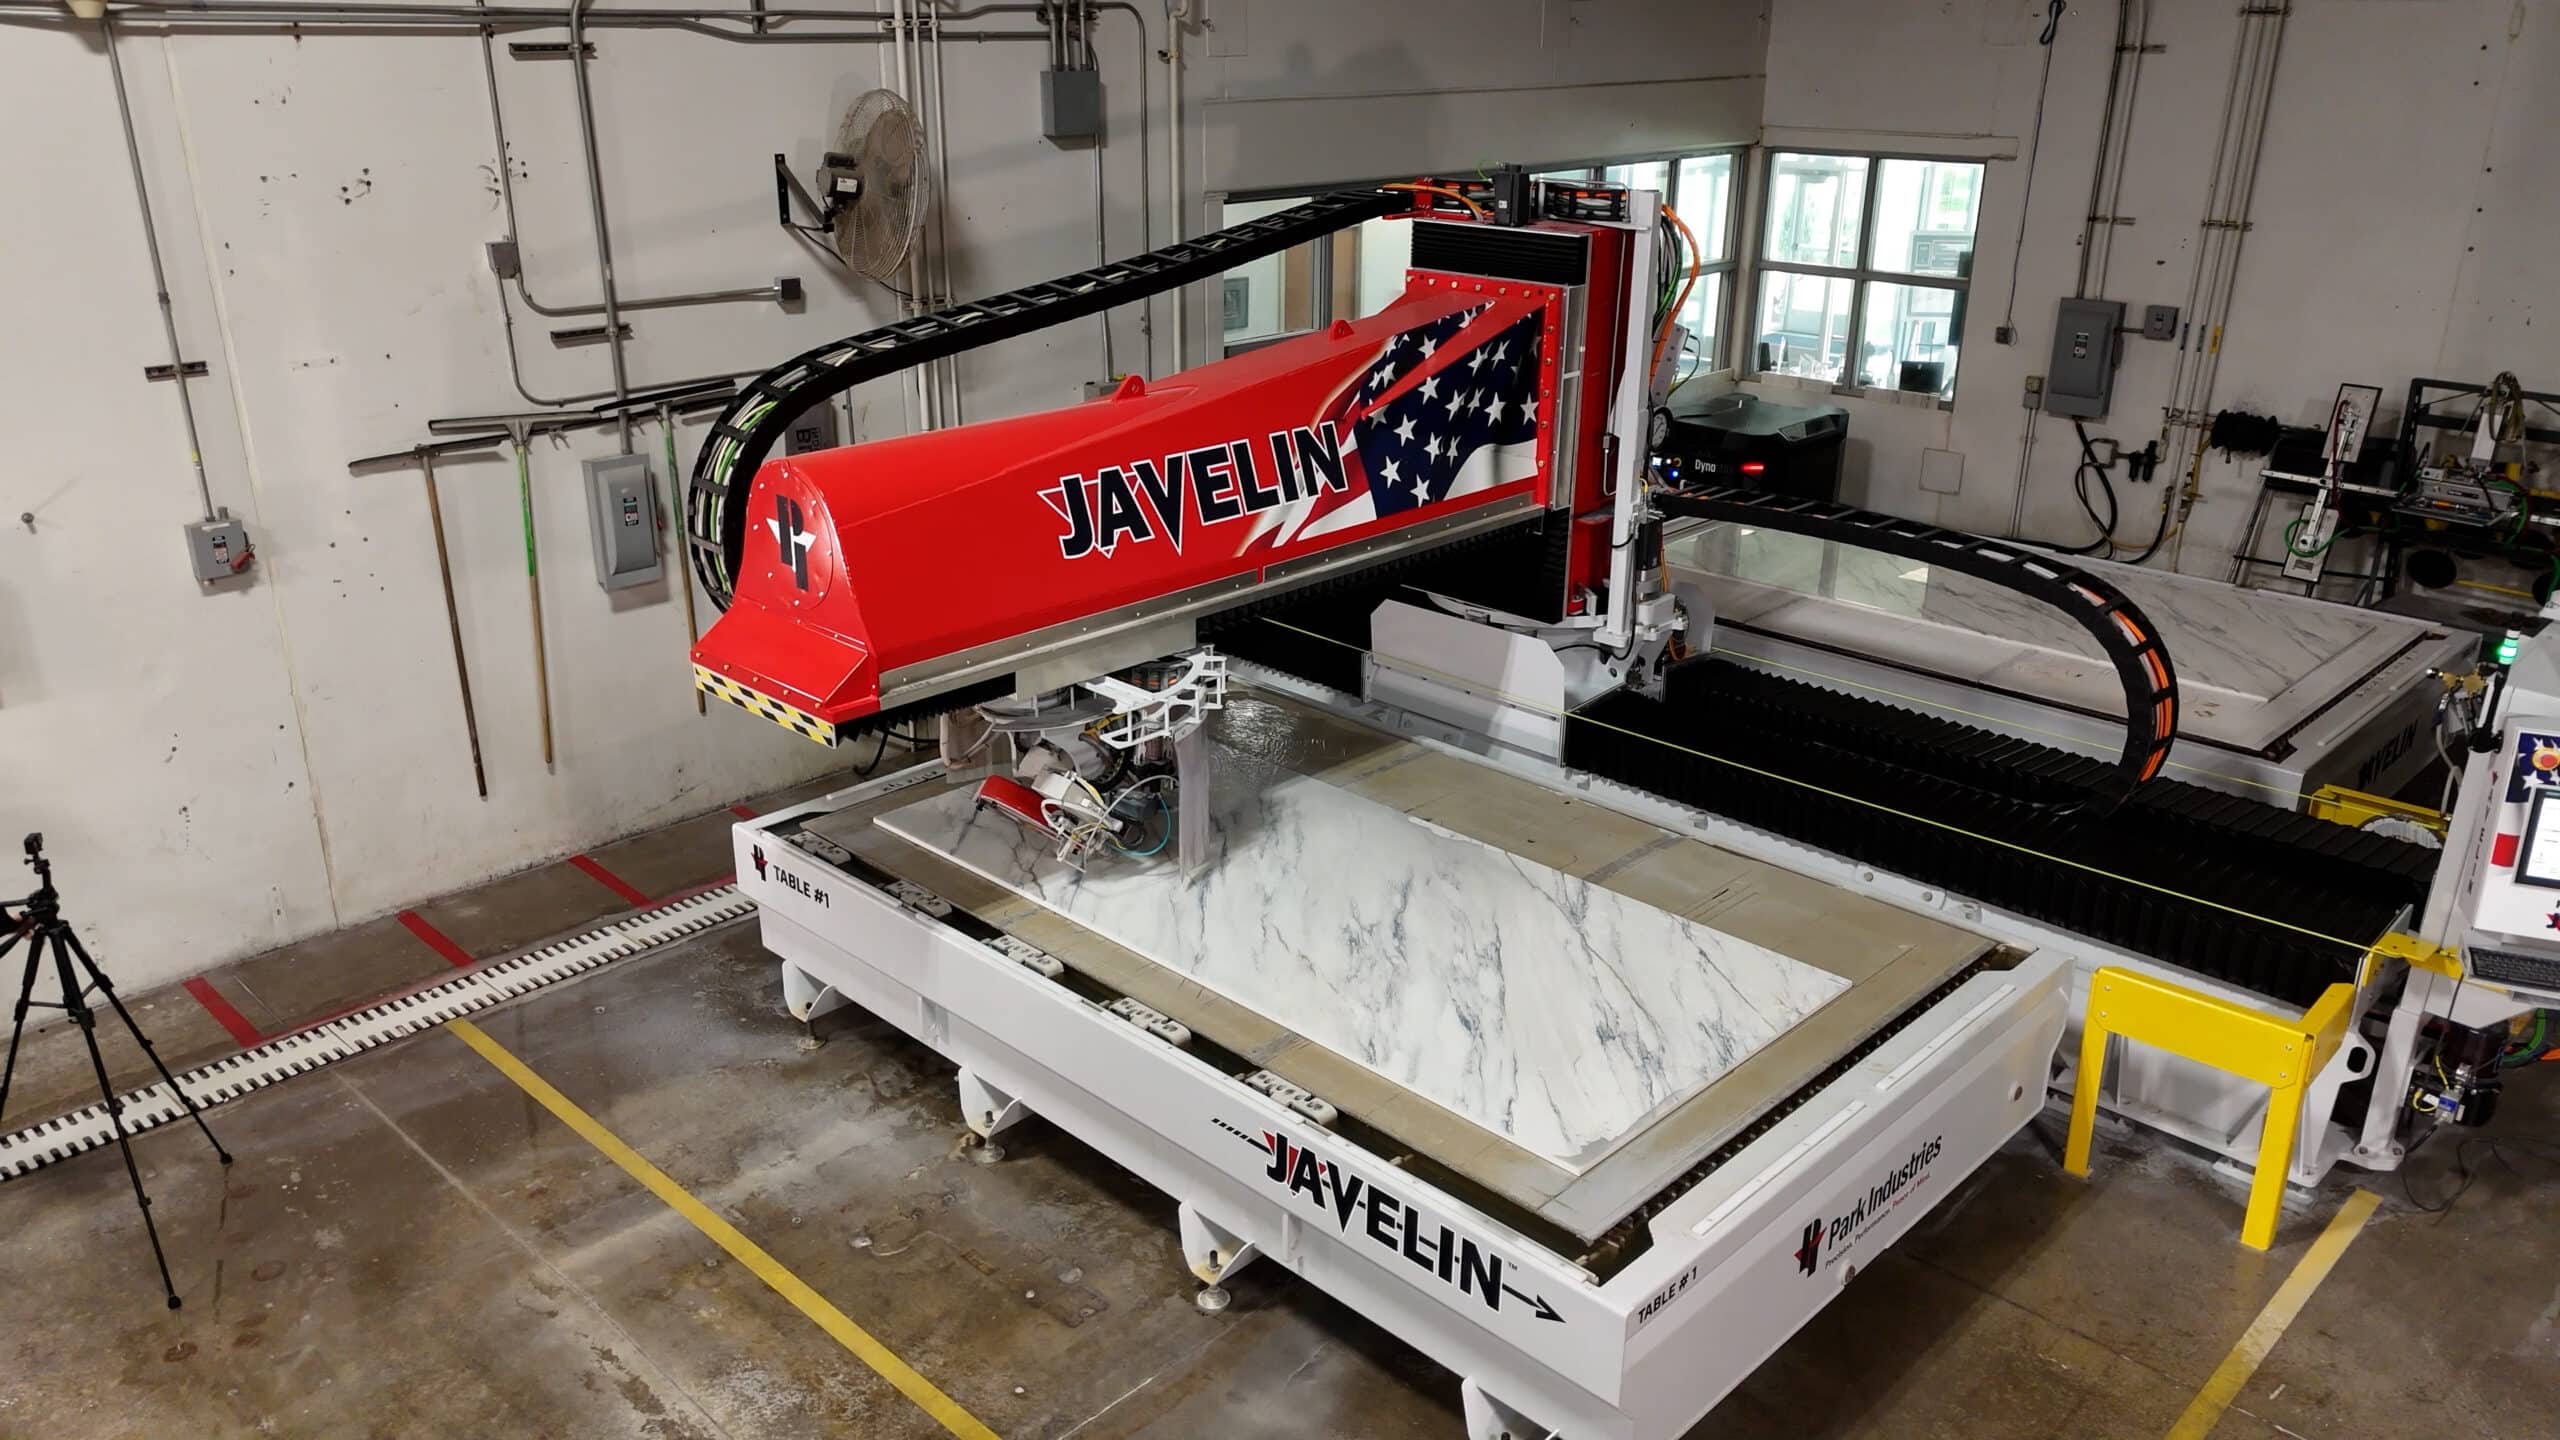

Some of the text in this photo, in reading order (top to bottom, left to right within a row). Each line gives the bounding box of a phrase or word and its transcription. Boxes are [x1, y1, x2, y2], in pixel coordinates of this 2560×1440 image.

[1058, 420, 1349, 560] JAVELIN
[773, 865, 829, 909] TABLE #1
[1266, 1131, 1502, 1312] JAVELIN
[1828, 1135, 1942, 1251] Park Industries
[1638, 1283, 1676, 1324] TABLE
